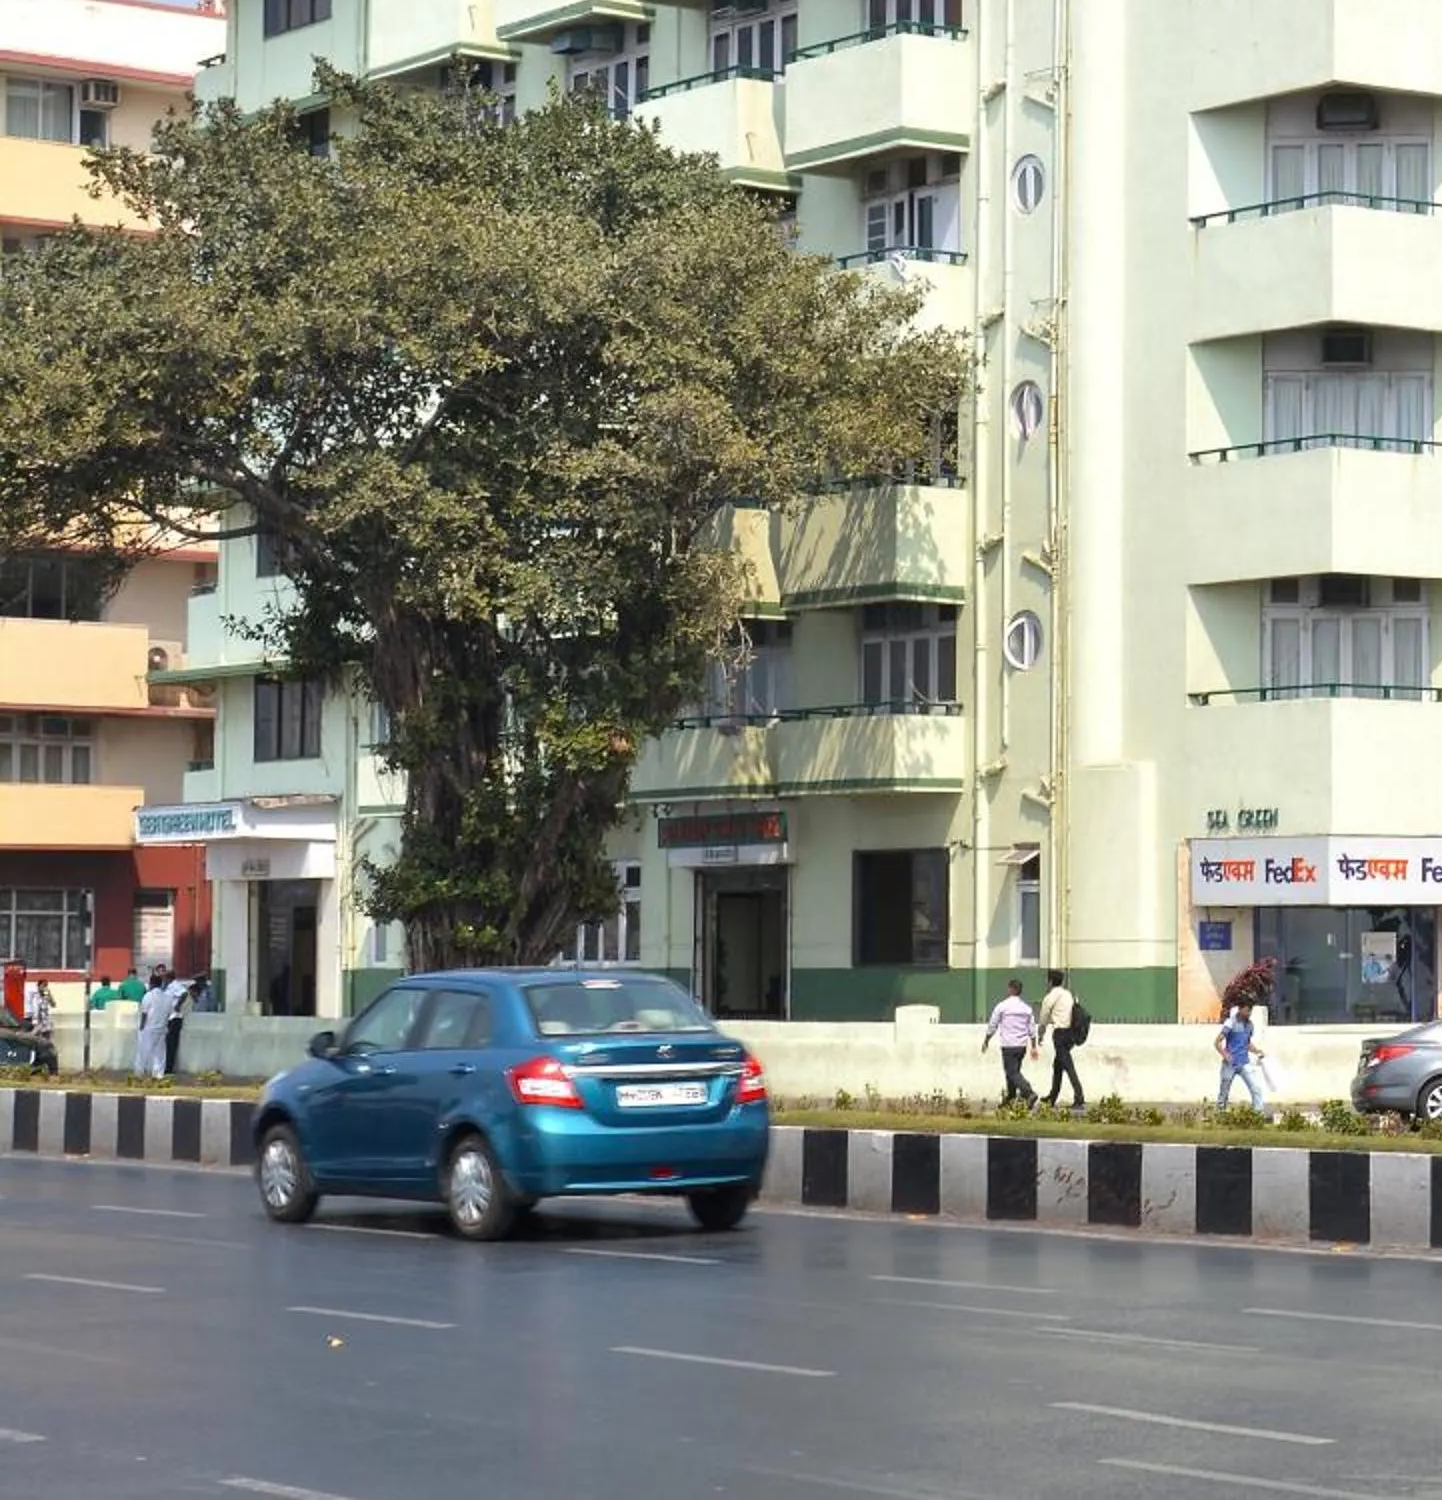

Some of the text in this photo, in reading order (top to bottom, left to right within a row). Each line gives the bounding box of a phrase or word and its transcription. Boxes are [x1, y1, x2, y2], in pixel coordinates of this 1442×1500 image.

[1207, 808, 1279, 829] SEA GREEN
[1265, 857, 1317, 883] FedEx
